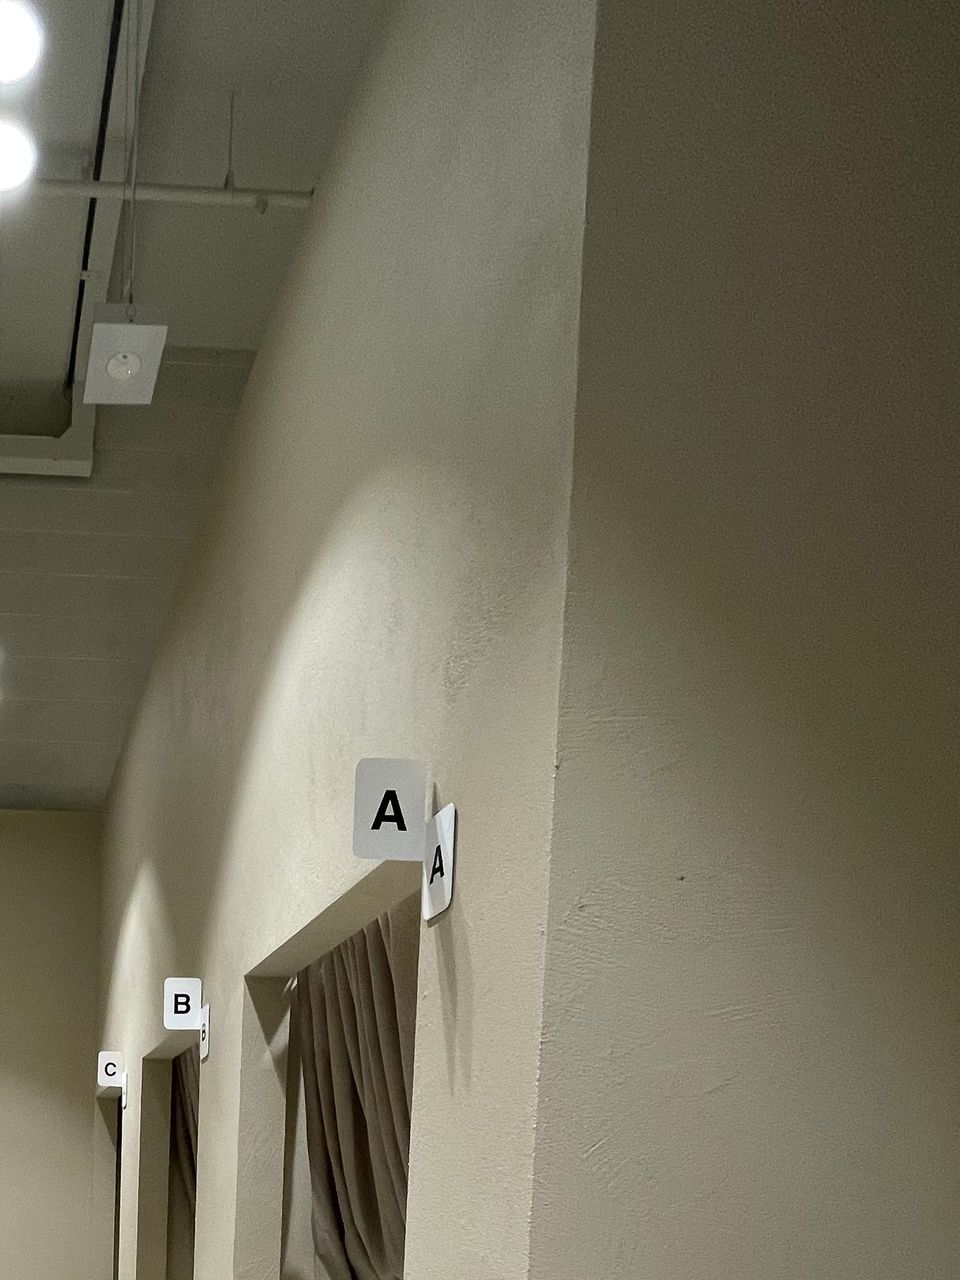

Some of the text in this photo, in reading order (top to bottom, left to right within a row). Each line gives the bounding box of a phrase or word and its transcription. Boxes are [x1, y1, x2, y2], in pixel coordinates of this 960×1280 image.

[371, 789, 408, 832] A
[429, 844, 445, 885] A
[173, 993, 191, 1015] B
[104, 1062, 117, 1077] C
